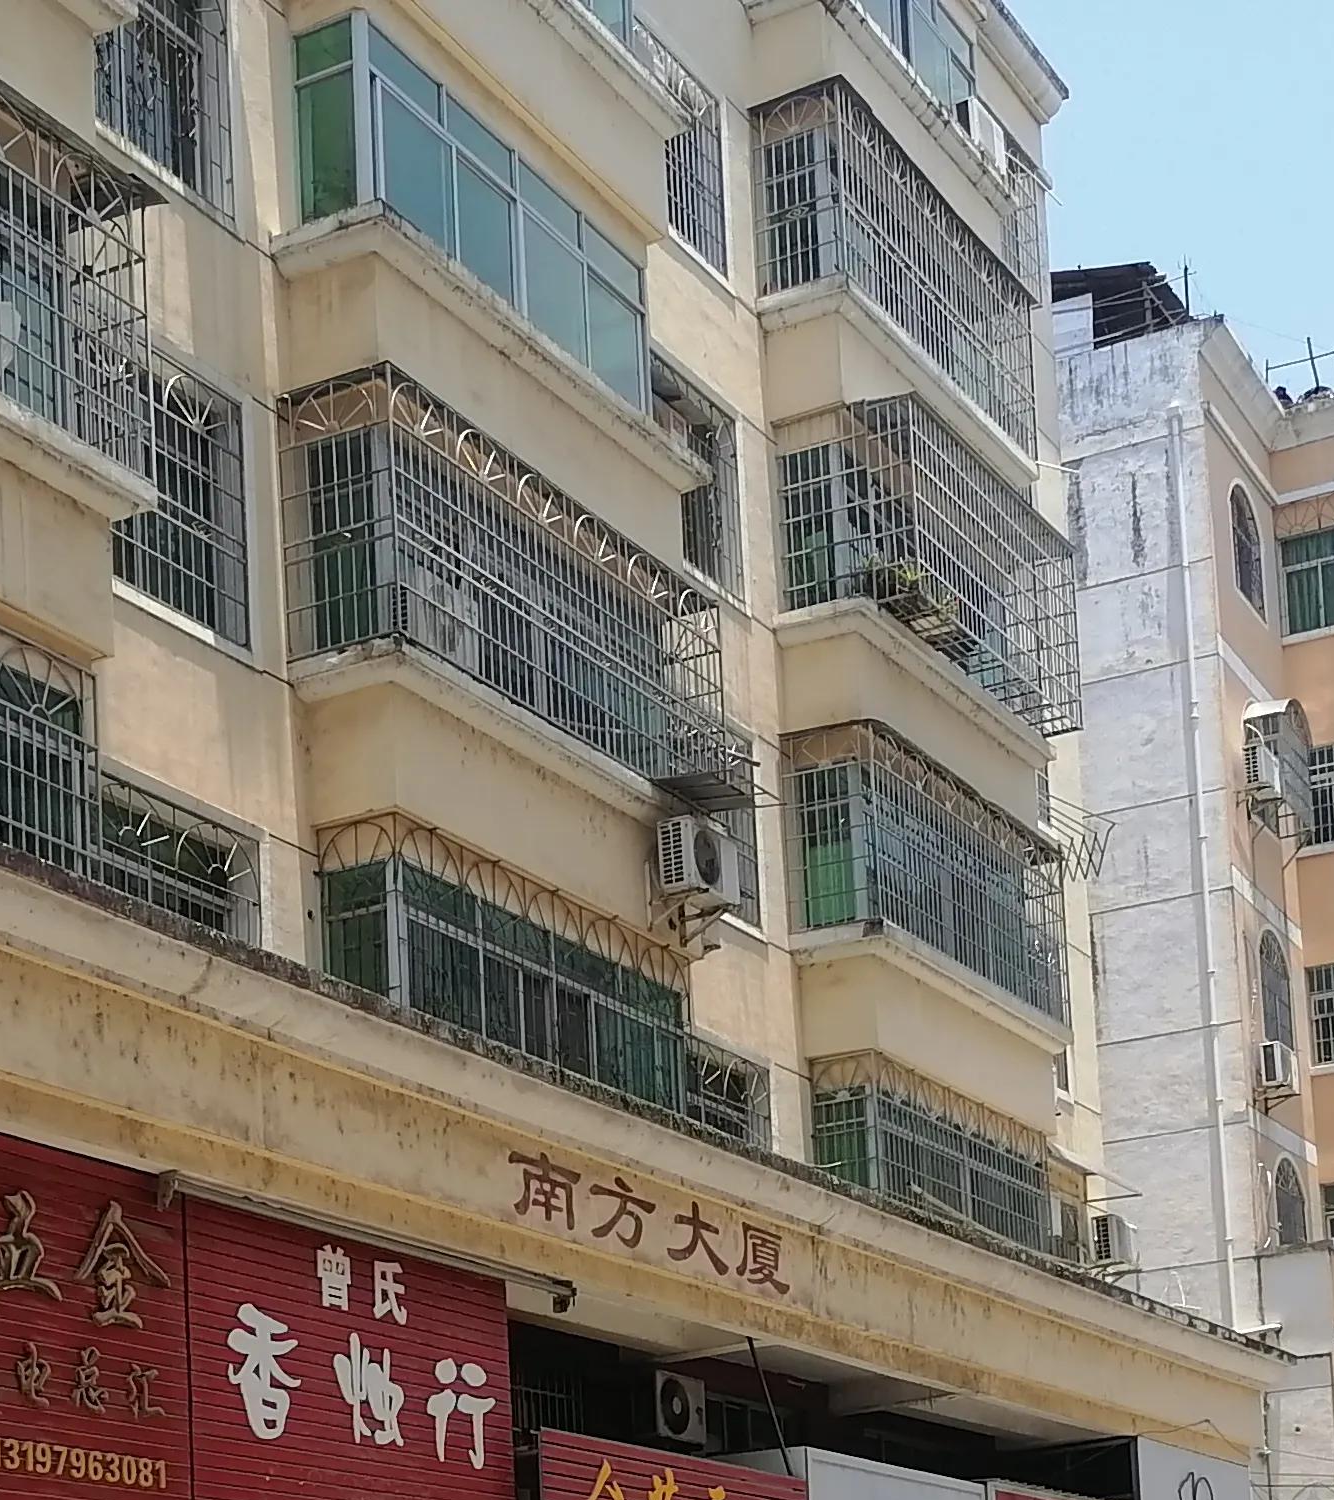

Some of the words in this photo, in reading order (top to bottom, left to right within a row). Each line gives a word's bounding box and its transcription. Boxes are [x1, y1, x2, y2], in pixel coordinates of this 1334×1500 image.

[317, 1244, 407, 1325] 曾氏
[508, 1150, 790, 1295] 南方大厦
[227, 1303, 496, 1470] 香烛行
